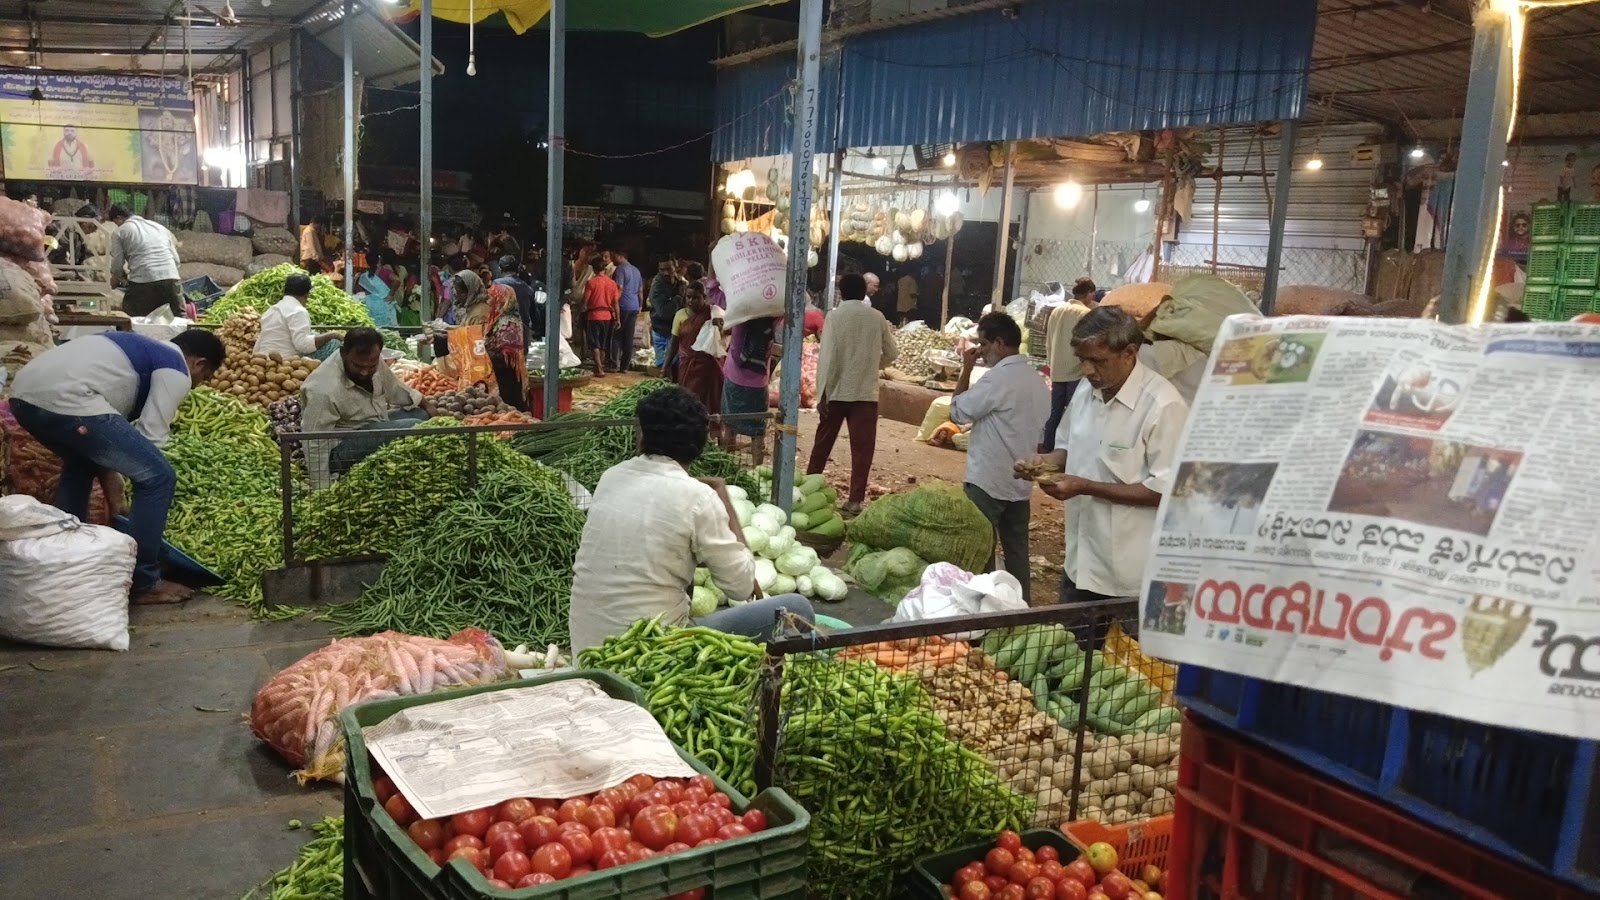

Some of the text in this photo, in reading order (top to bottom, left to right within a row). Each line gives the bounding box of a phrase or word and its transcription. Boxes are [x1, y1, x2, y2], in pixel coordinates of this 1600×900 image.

[746, 252, 774, 264] PELLET
[1356, 523, 1425, 555] ಮತ
[1429, 536, 1575, 585] ನಿಮಗೇಕೆ
[1197, 580, 1600, 681] ಮ್ಮ ಬೆಂಗಳೂರು
